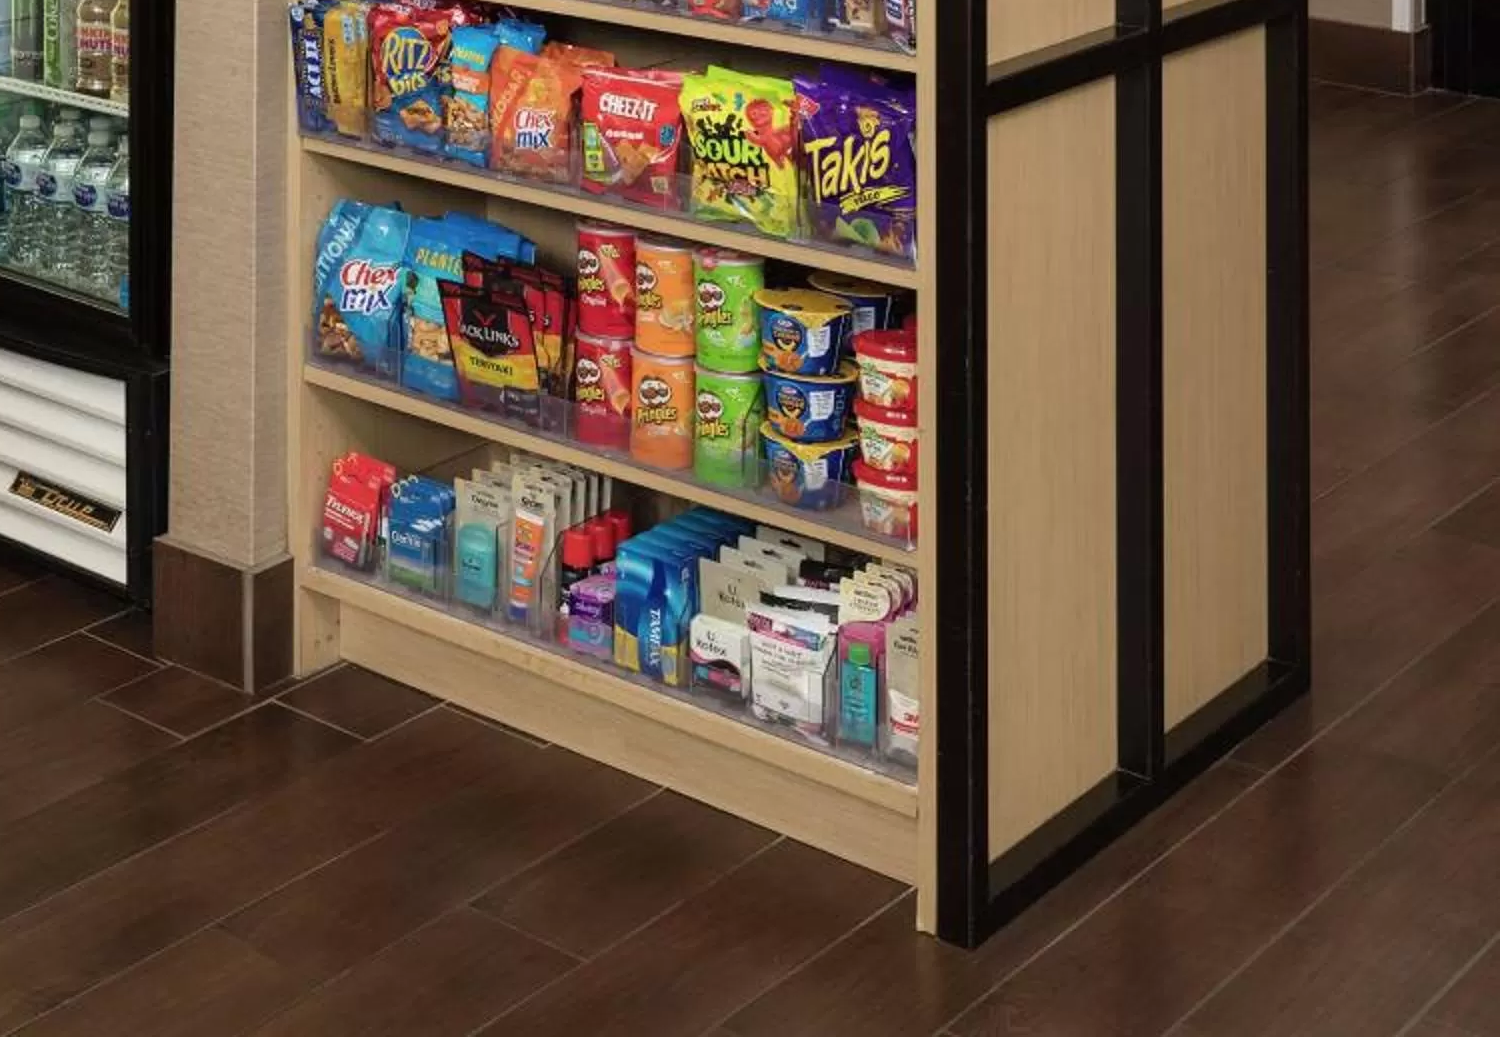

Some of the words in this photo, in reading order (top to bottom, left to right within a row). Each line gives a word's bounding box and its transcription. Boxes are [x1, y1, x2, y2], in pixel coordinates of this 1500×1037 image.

[382, 32, 431, 77] RITZ
[514, 108, 556, 132] Chex
[695, 133, 762, 166] SOUR
[692, 160, 769, 188] PATCH
[803, 129, 892, 207] Takis
[340, 259, 399, 287] Chex
